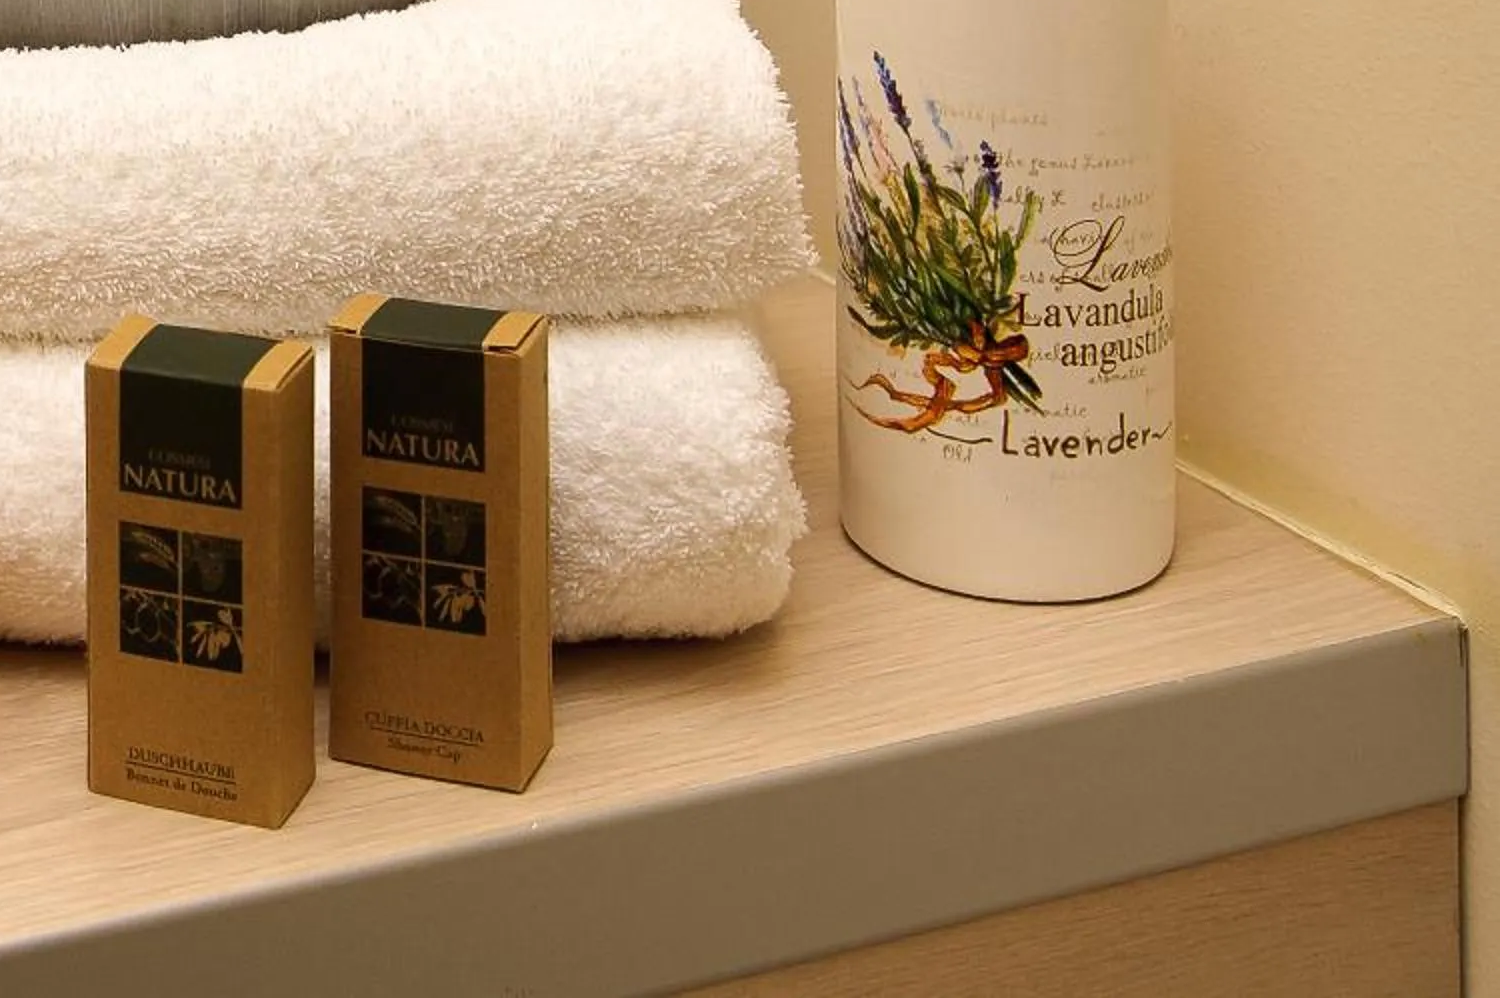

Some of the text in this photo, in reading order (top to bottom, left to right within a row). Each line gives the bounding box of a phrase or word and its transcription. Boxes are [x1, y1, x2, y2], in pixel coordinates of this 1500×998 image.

[1016, 283, 1164, 328] Lavandula
[367, 428, 481, 468] NATURA
[1001, 409, 1150, 458] Lavender
[124, 462, 237, 503] NATURA
[364, 710, 485, 744] CUFFIA DOCCIA
[127, 745, 236, 780] DUSCHHAUBE
[172, 776, 187, 792] de
[190, 780, 238, 802] Douche
